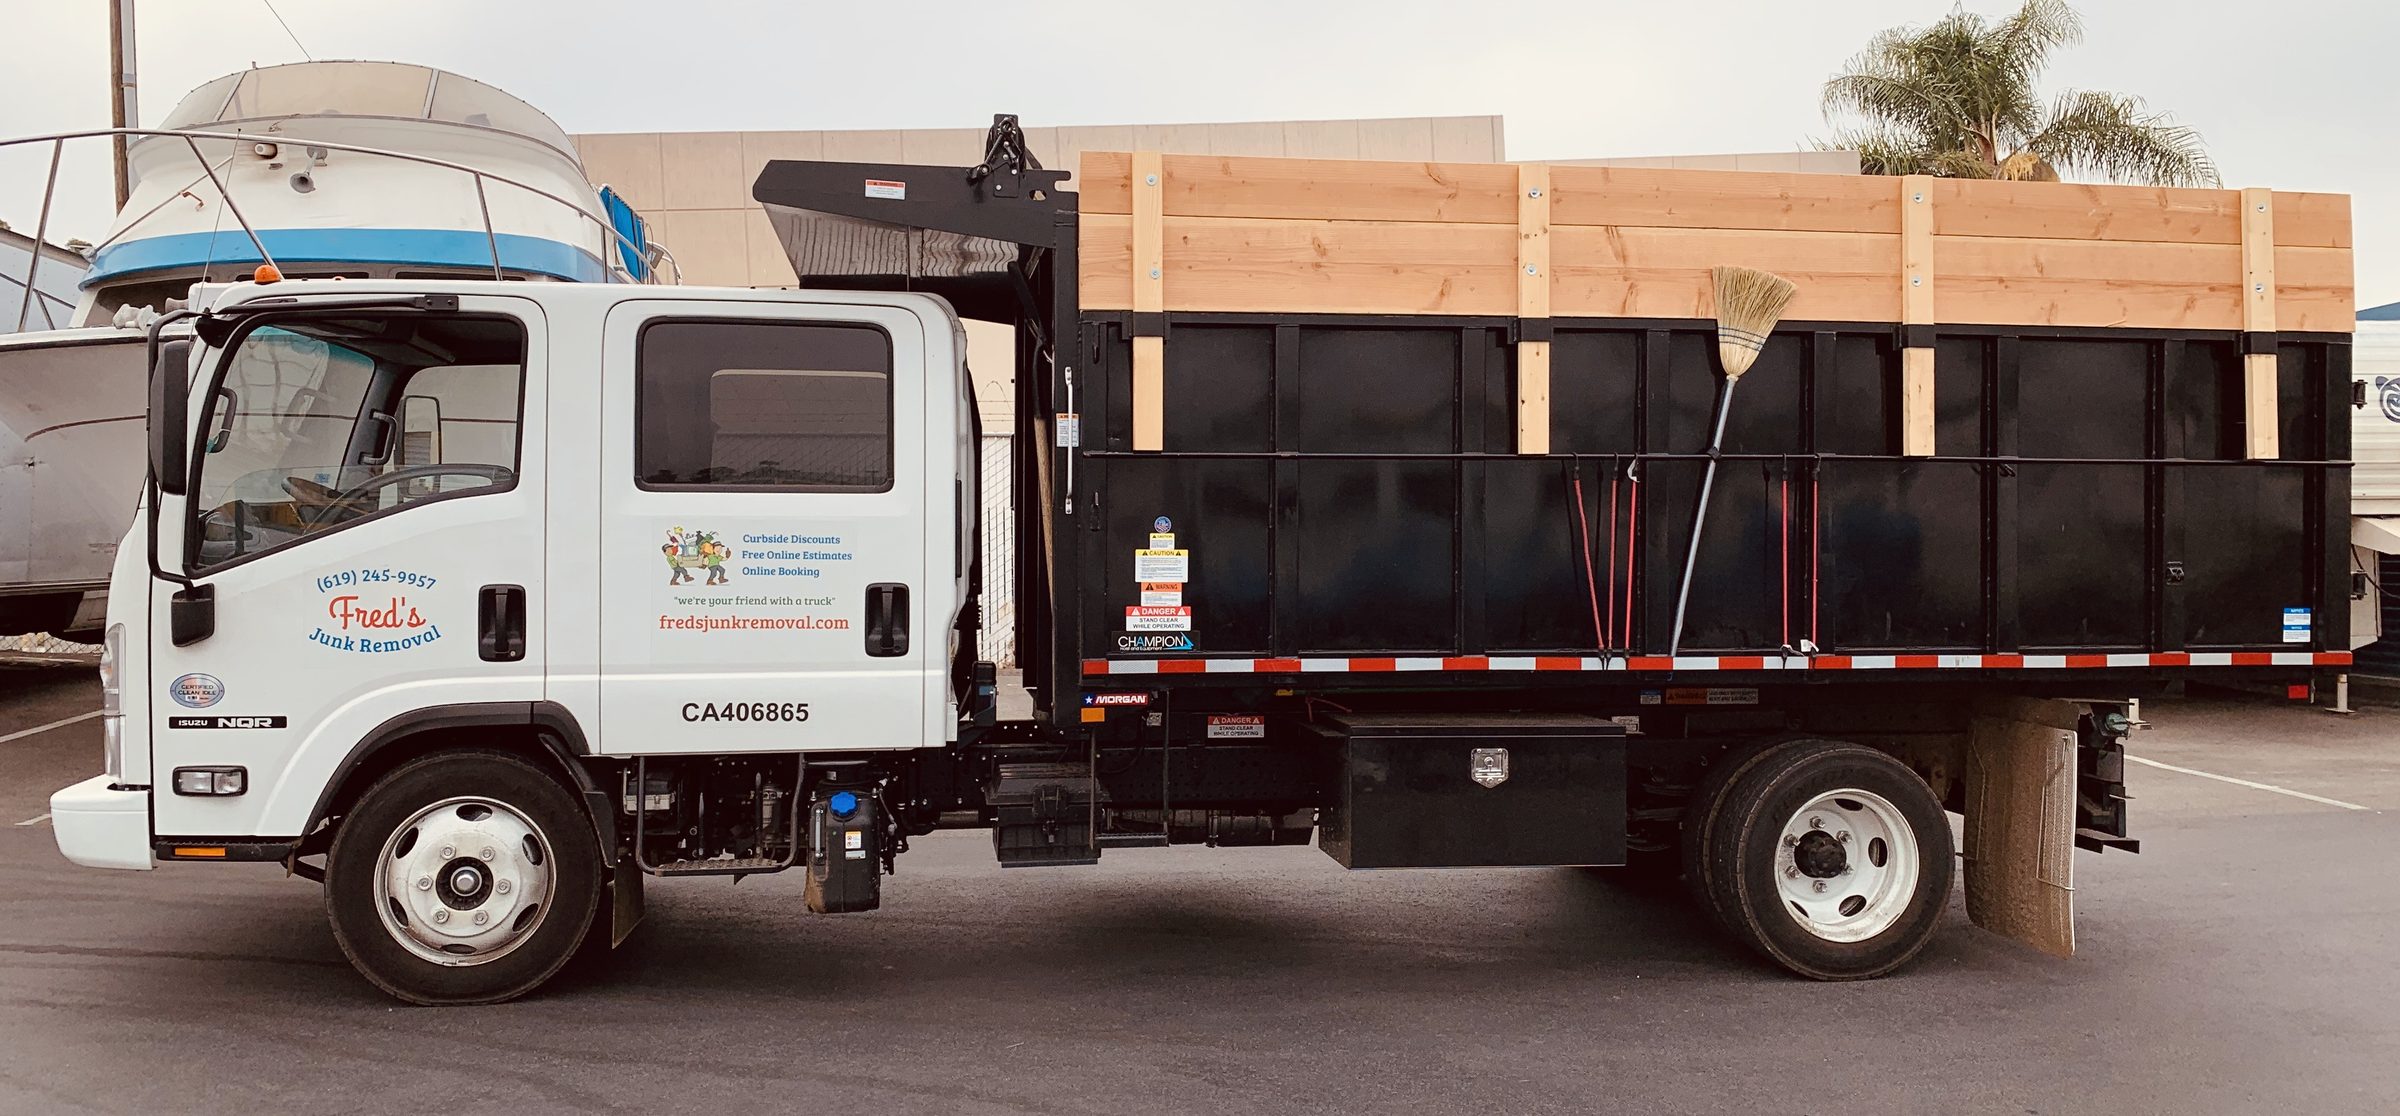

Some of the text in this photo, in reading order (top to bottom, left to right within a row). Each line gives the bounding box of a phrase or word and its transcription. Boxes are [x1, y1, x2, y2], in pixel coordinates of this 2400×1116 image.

[742, 534, 841, 545] Curbside Discounts
[742, 550, 852, 561] Free Online Estimates
[742, 566, 820, 578] Online Booking
[317, 569, 437, 593] (619) 245-9957
[674, 596, 836, 607] "we're your friend with a truck"
[329, 595, 427, 630] Fred's
[659, 615, 850, 633] fredsjunkremoval.com
[309, 625, 442, 653] Junk Removal
[1117, 635, 1184, 648] CHAMPION
[1095, 695, 1146, 704] MORGAN
[682, 702, 809, 722] CA406865
[217, 718, 273, 728] NQR
